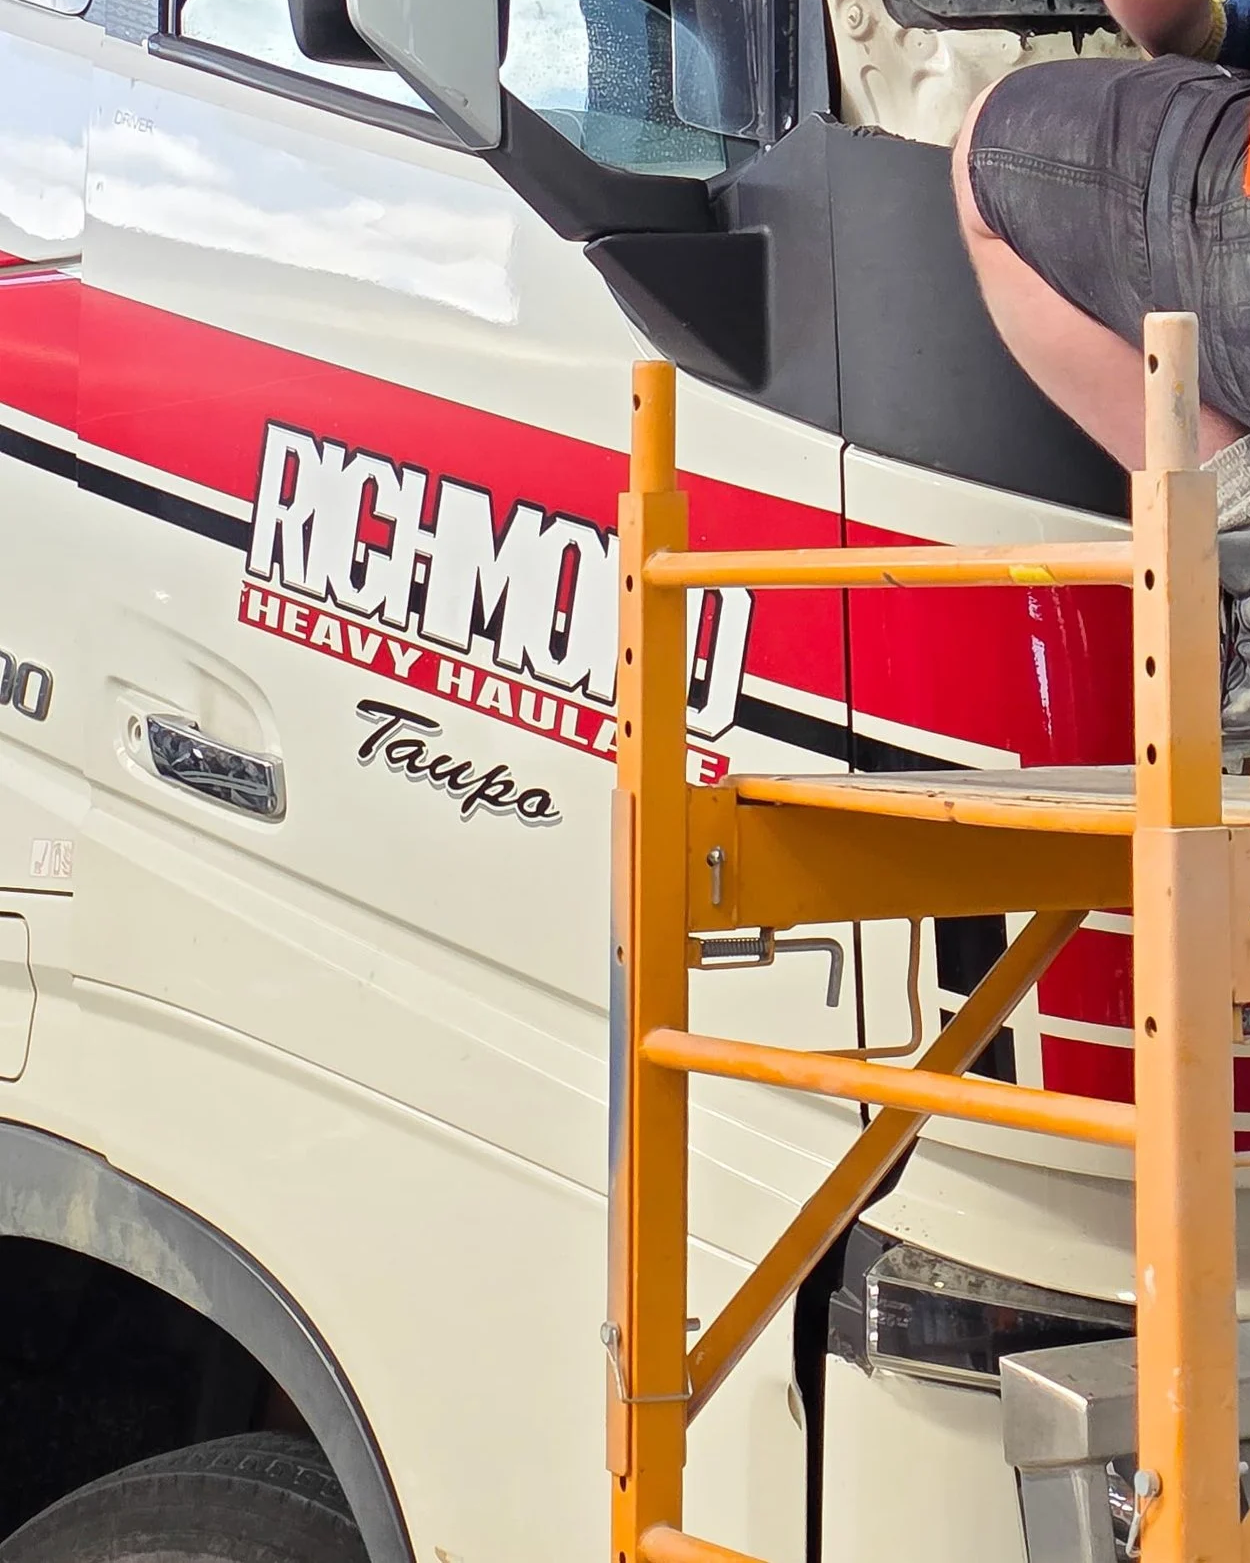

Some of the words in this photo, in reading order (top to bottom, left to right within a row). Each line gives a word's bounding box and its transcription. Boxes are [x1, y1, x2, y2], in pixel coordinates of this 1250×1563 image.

[245, 417, 755, 743] RICHMOD
[246, 593, 423, 679] HEAVY
[436, 652, 719, 787] HAULAE
[355, 698, 562, 825] Taupo
